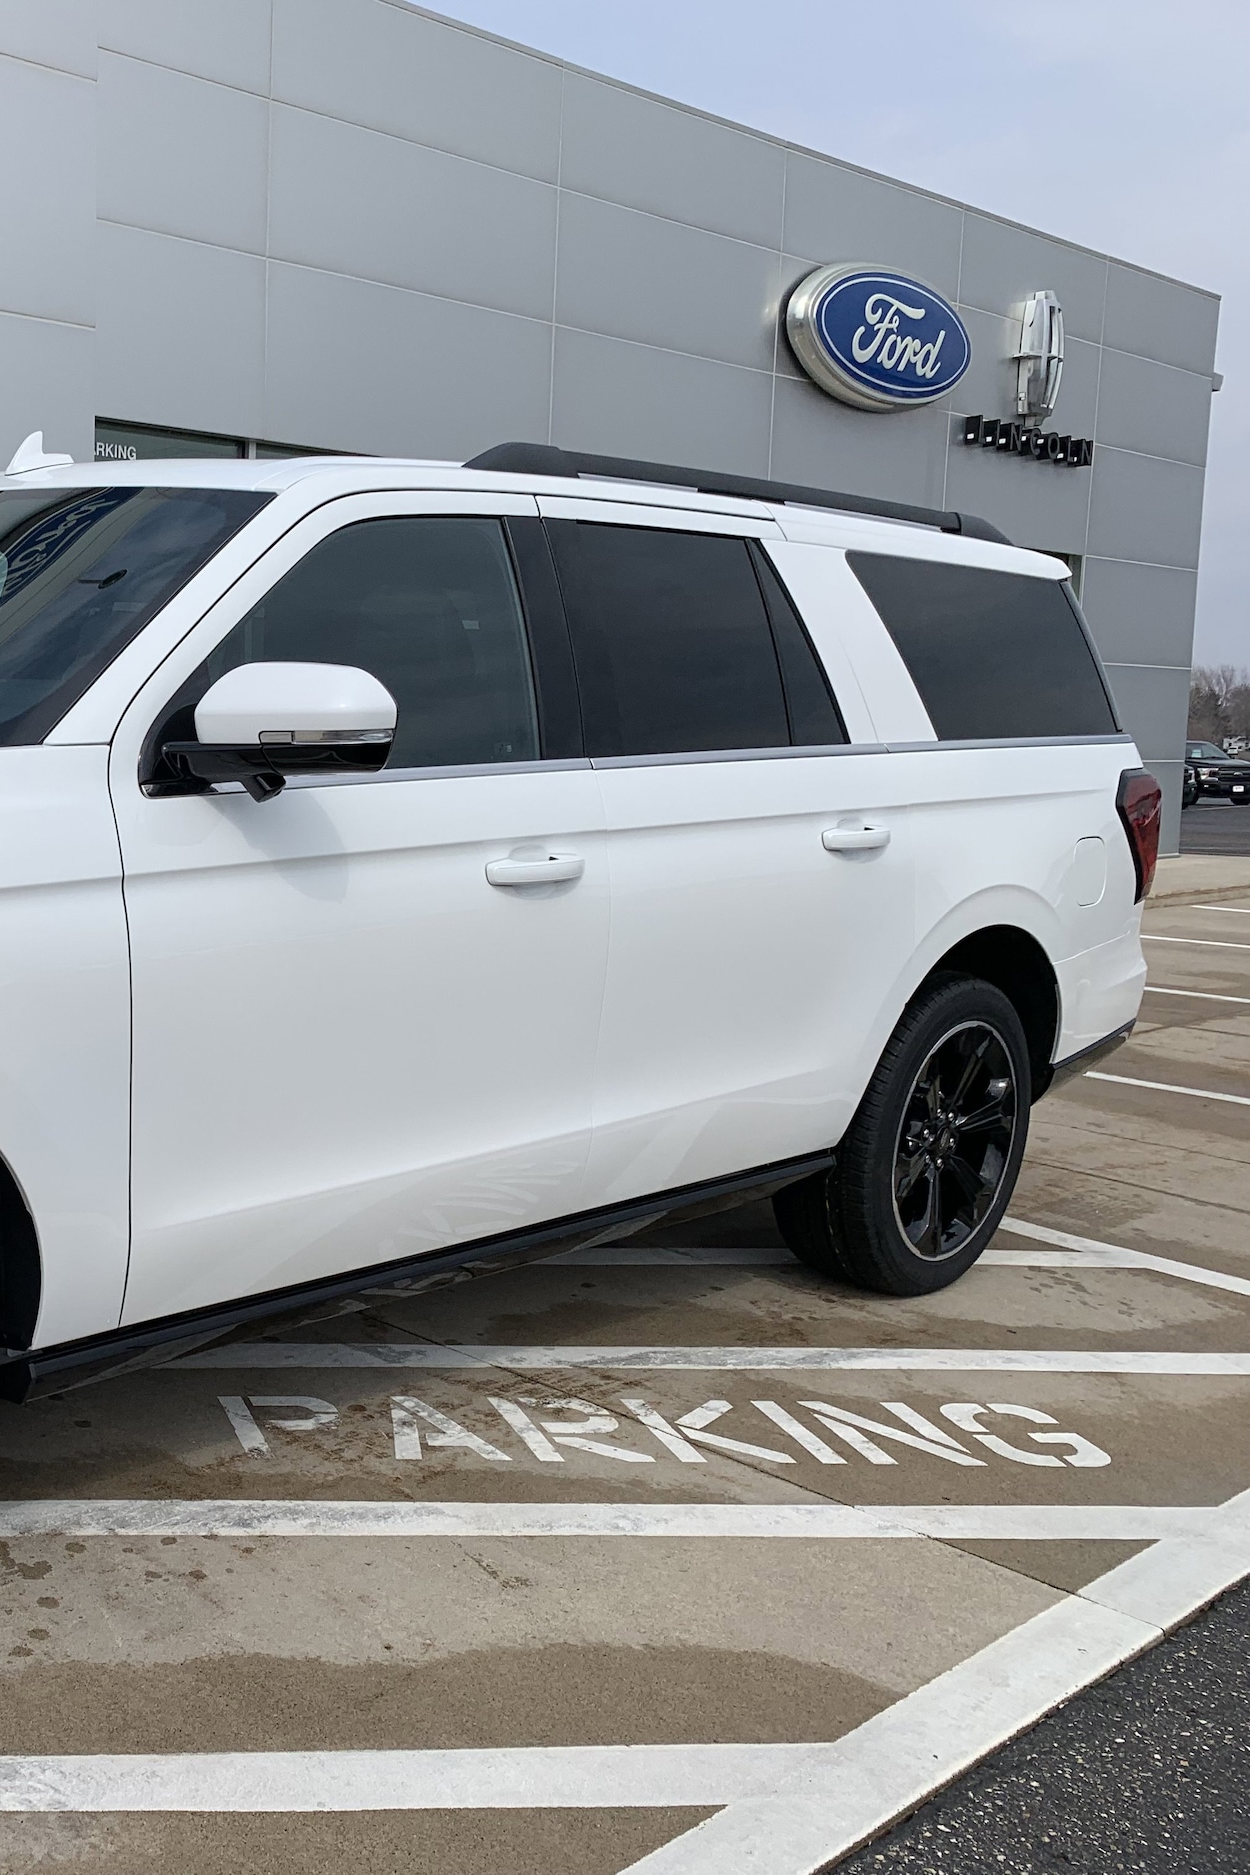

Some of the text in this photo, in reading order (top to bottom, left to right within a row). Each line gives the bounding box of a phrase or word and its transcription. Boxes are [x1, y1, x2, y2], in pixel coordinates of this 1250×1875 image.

[852, 293, 946, 380] Ford
[94, 441, 137, 460] RKING
[965, 414, 1093, 467] LINCOLN
[217, 1396, 1111, 1468] PARKING
